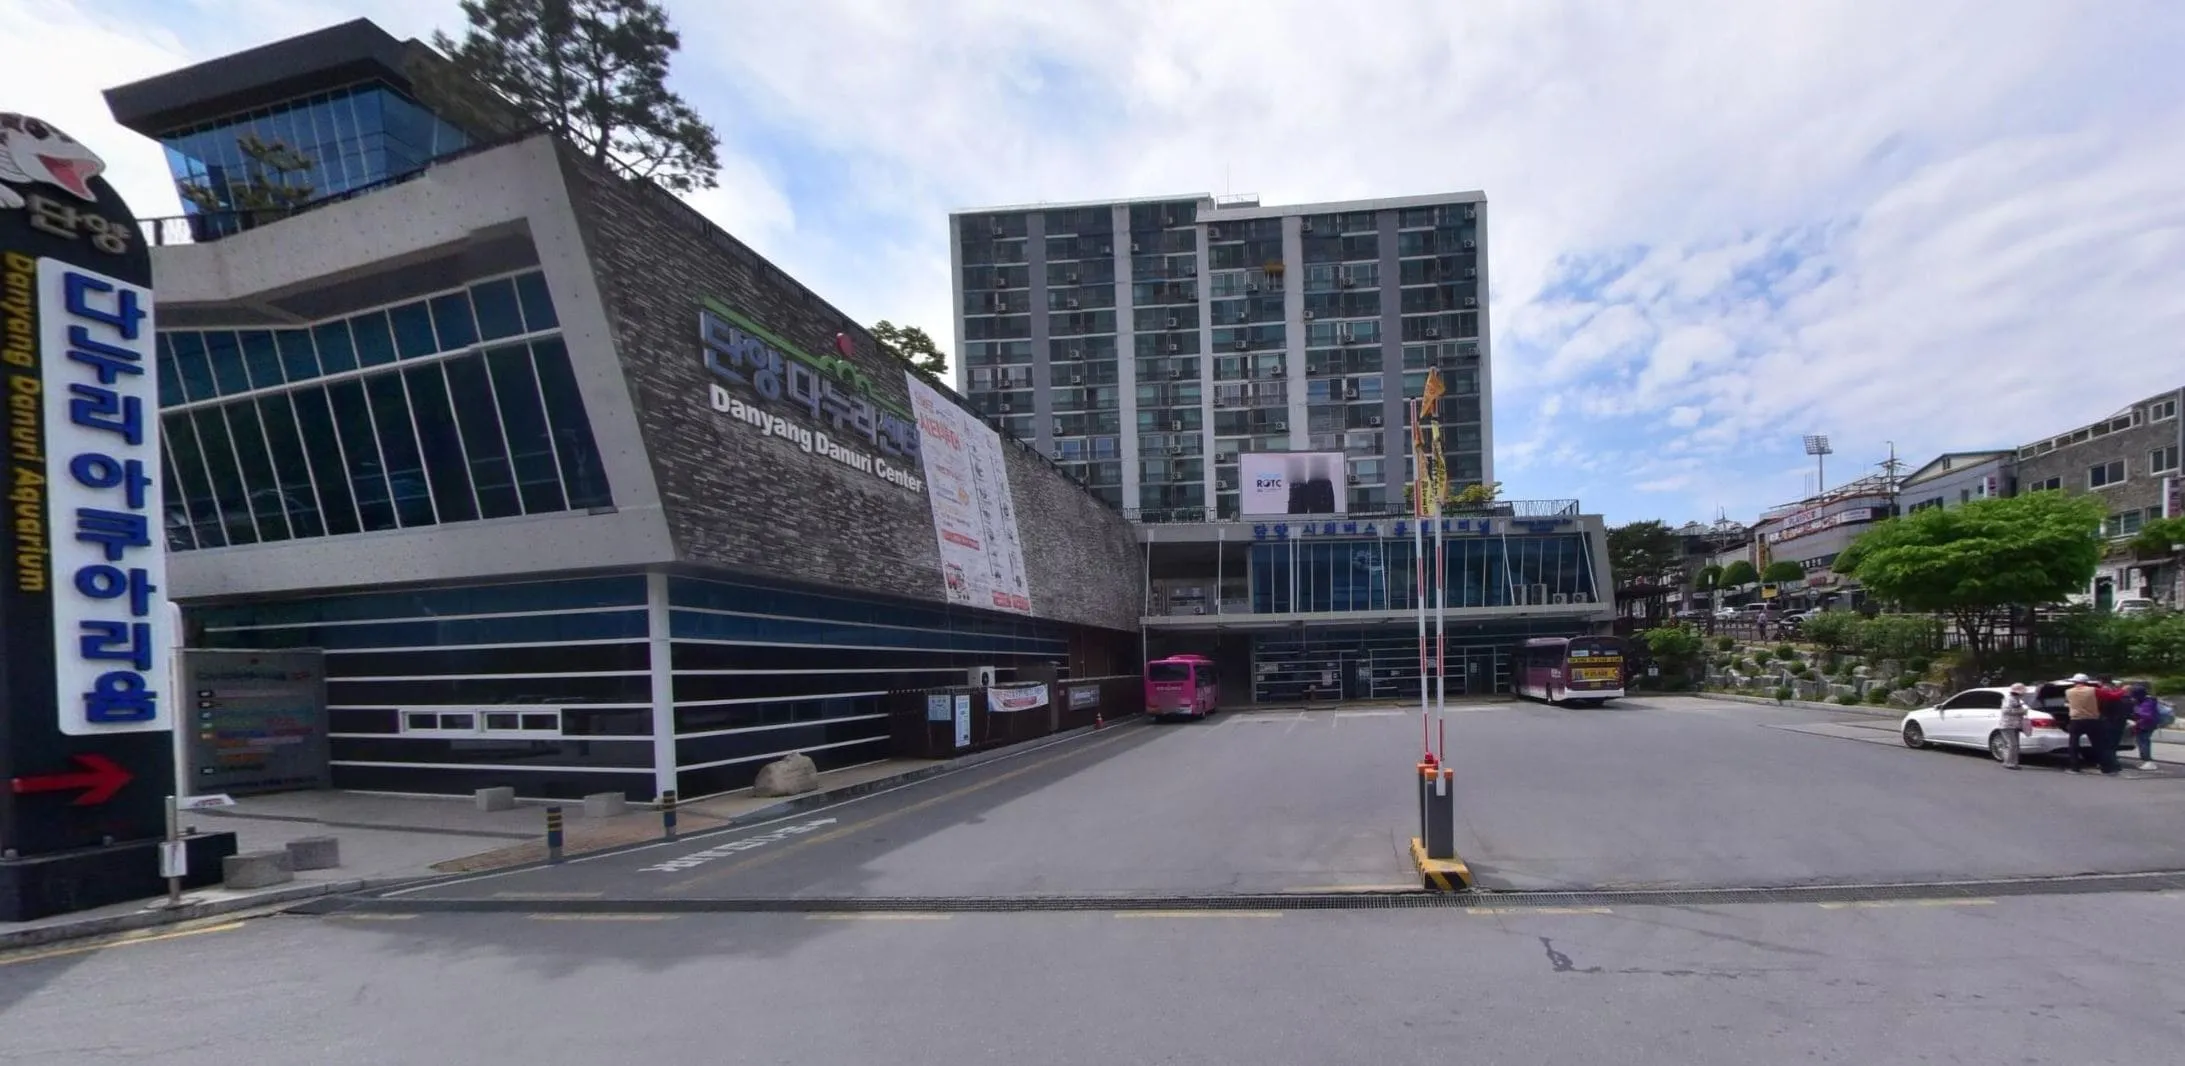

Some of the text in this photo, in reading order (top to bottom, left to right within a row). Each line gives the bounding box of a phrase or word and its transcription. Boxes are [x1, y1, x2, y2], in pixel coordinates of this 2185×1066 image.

[27, 194, 132, 254] 단양
[700, 311, 784, 401] 단양
[2, 251, 49, 592] Danyang Danuri Aquarium
[709, 383, 923, 493] Danyang Danuri Center
[64, 271, 157, 724] 다누리아쿠아리움
[1256, 479, 1282, 488] ROTC
[1253, 522, 1289, 541] 단양
[1303, 521, 1376, 536] 시외버스
